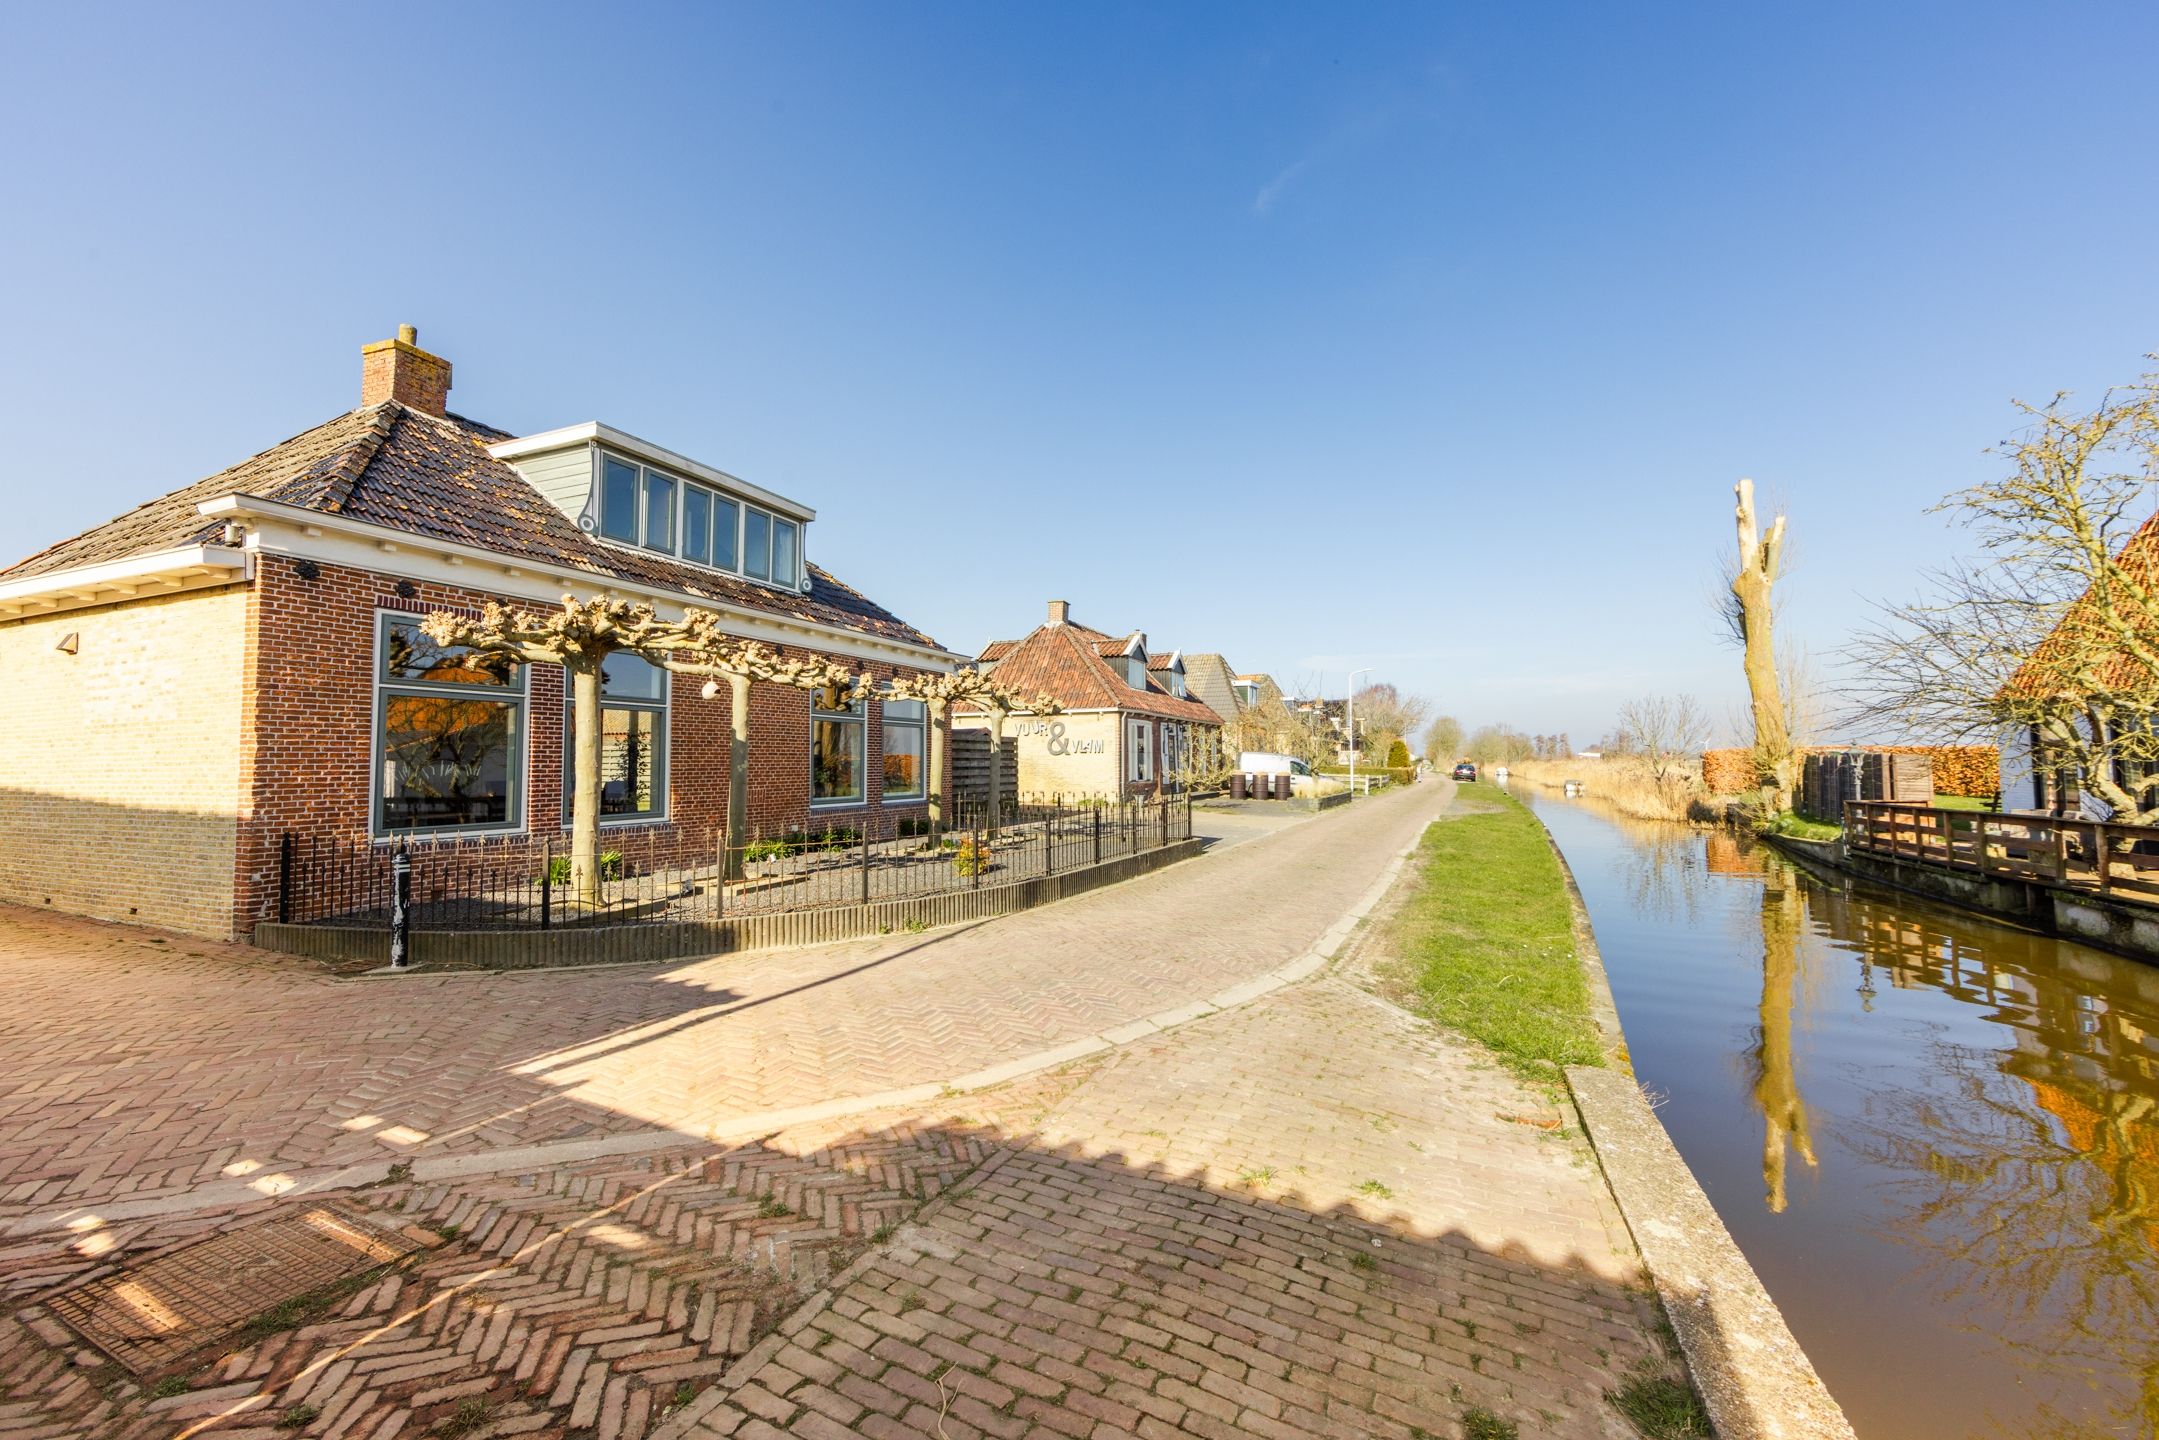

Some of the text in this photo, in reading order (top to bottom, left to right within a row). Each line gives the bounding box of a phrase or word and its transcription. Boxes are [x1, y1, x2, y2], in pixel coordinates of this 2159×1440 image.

[1015, 721, 1104, 756] VUUR & VLAM
